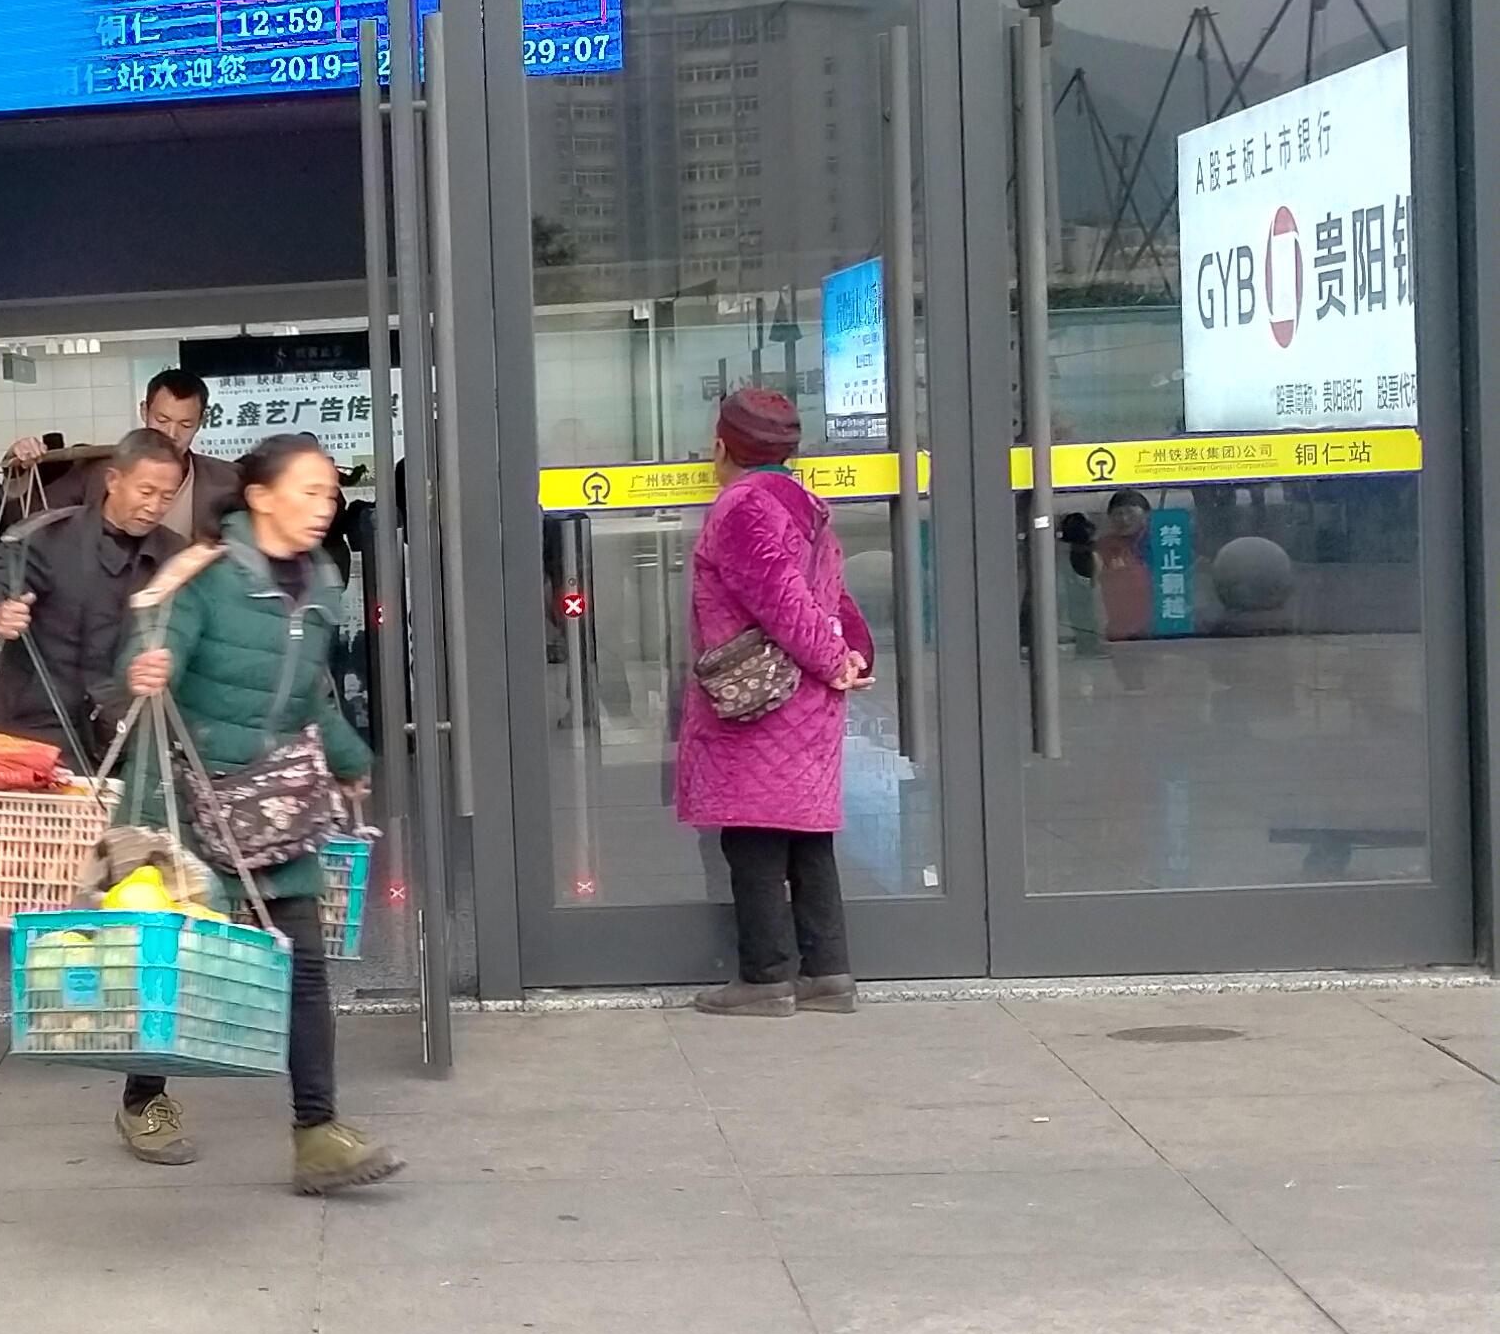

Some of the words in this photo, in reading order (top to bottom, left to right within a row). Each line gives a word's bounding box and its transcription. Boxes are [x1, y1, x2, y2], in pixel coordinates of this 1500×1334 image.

[236, 6, 323, 38] 12:59
[1196, 110, 1332, 195] A股主板上市银行
[1197, 245, 1256, 330] GYB
[1137, 443, 1273, 463] 广州铁路(集团)公司
[1295, 440, 1372, 466] 铜仁站
